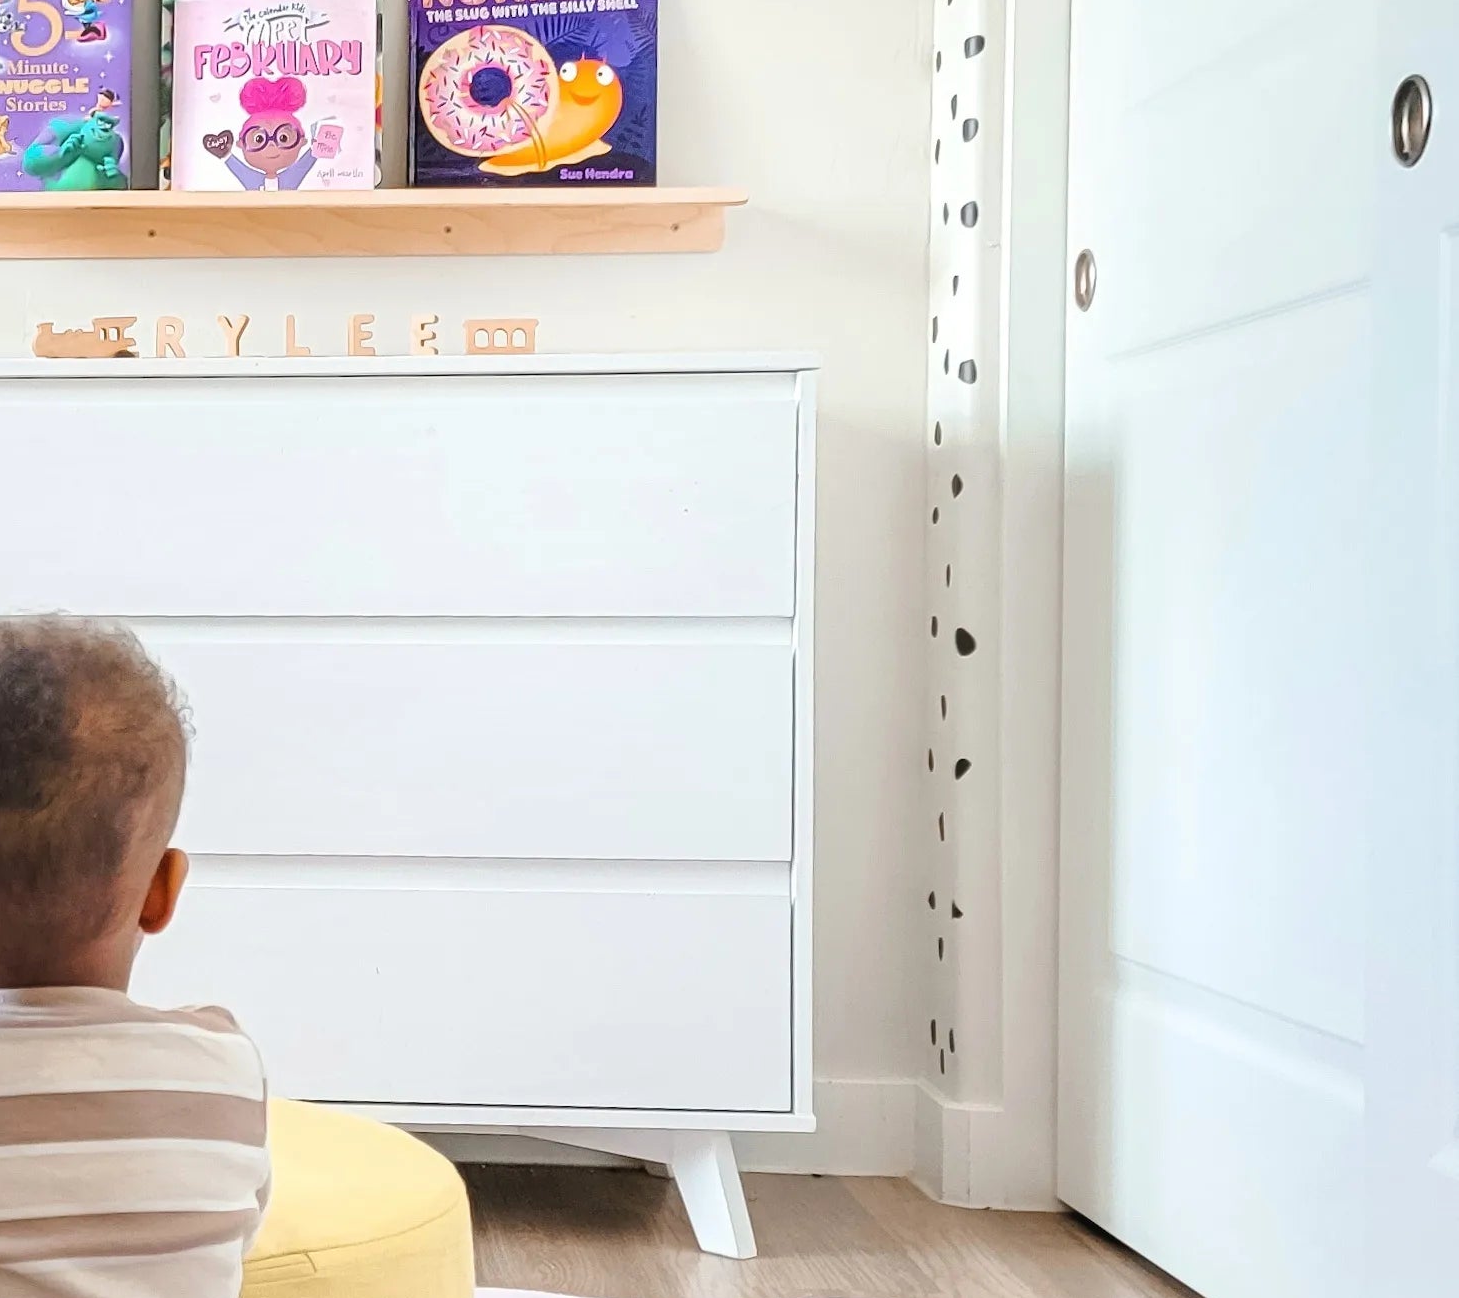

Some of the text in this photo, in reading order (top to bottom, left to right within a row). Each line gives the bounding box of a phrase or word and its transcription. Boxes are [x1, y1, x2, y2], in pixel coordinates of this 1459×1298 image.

[426, 10, 453, 23] THE
[455, 7, 490, 22] SLUG
[492, 4, 529, 19] WITH
[530, 2, 558, 16] THE
[560, 0, 595, 15] SILLY
[7, 61, 70, 76] Minute
[5, 97, 67, 112] Stories
[559, 166, 634, 180] Sue Hendra
